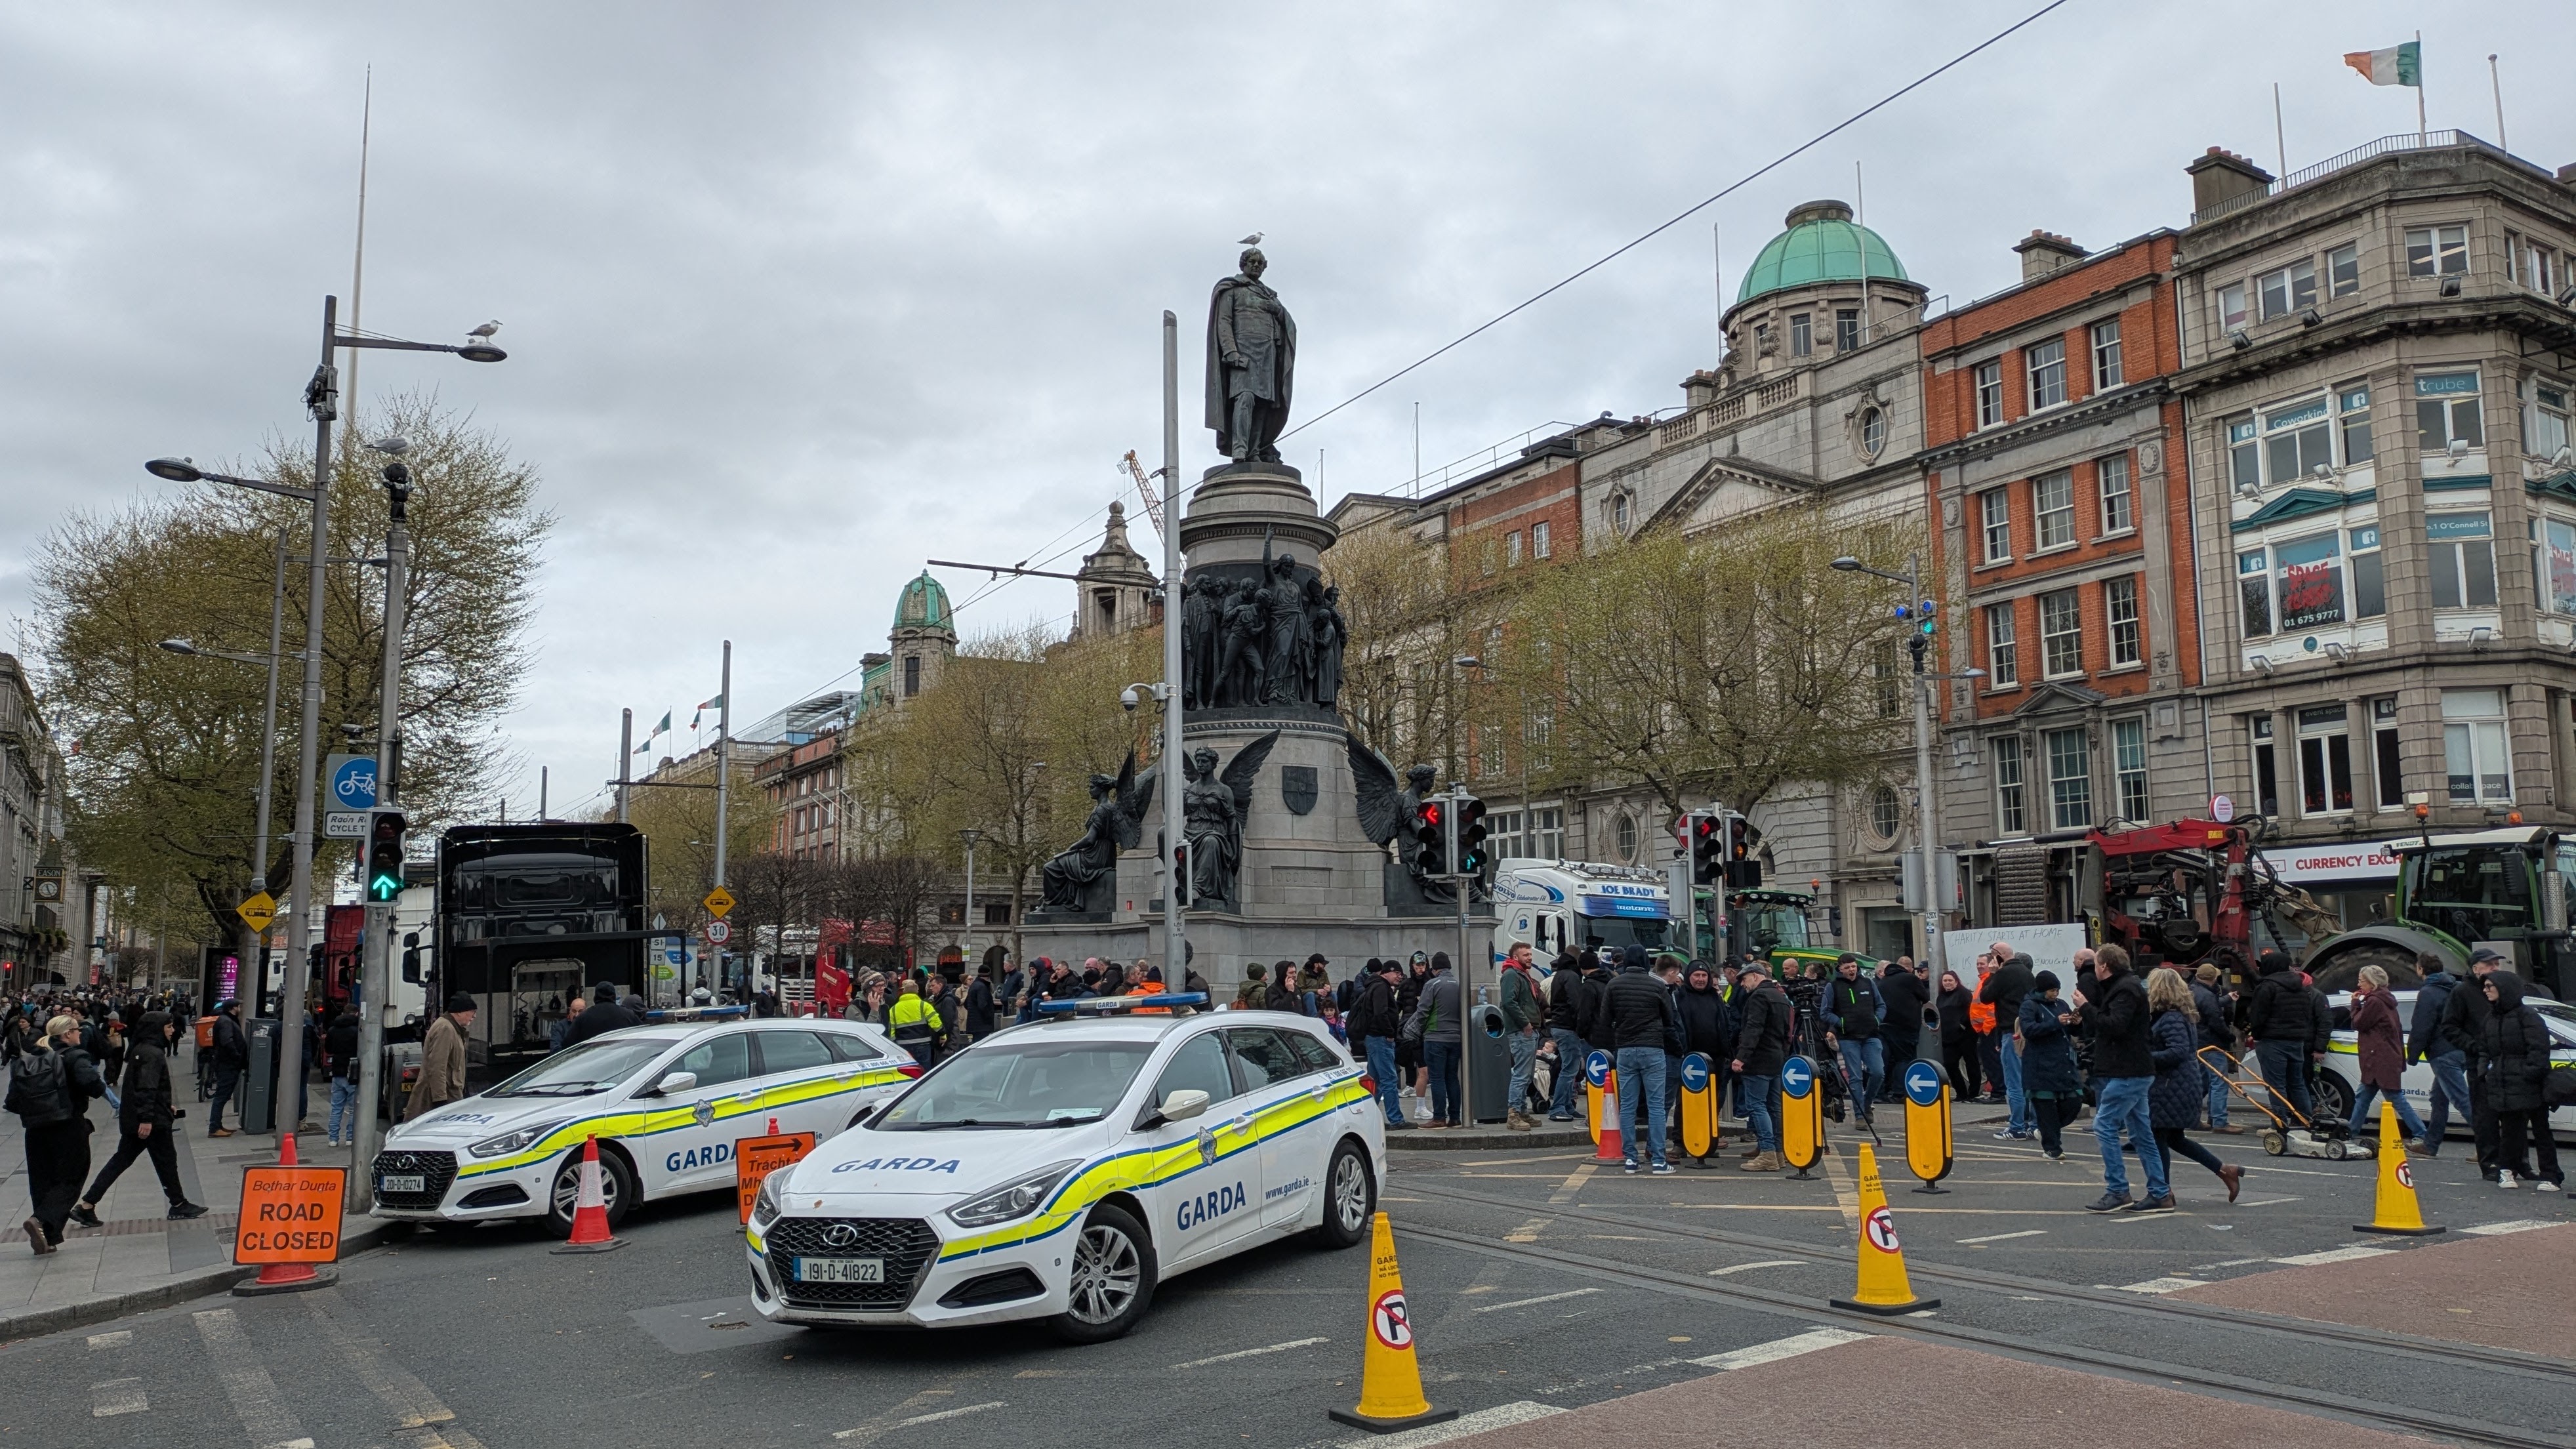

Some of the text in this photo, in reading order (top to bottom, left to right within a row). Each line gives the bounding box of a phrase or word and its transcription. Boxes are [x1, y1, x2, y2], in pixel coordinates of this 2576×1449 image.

[2284, 609, 2339, 627] 01 675 9777
[2305, 706, 2345, 716] event space
[2296, 855, 2363, 870] CURRENCY
[1494, 884, 1515, 899] VOLVO
[1601, 886, 1655, 897] JOE BRADY
[712, 926, 724, 936] 30
[1950, 928, 2062, 947] CHARITY STARTS AT HOME
[2034, 957, 2069, 967] ENOUGH
[426, 1114, 495, 1124] GARDA
[832, 1158, 960, 1173] GARDA
[253, 1181, 337, 1191] Bothar Dunta
[386, 1179, 421, 1190] 201-D-10274
[1265, 1176, 1309, 1200] www.garda.ie
[260, 1203, 323, 1221] ROAD
[1177, 1181, 1246, 1231] GARDA
[243, 1232, 333, 1250] CLOSED
[809, 1263, 877, 1280] 191-D-41822
